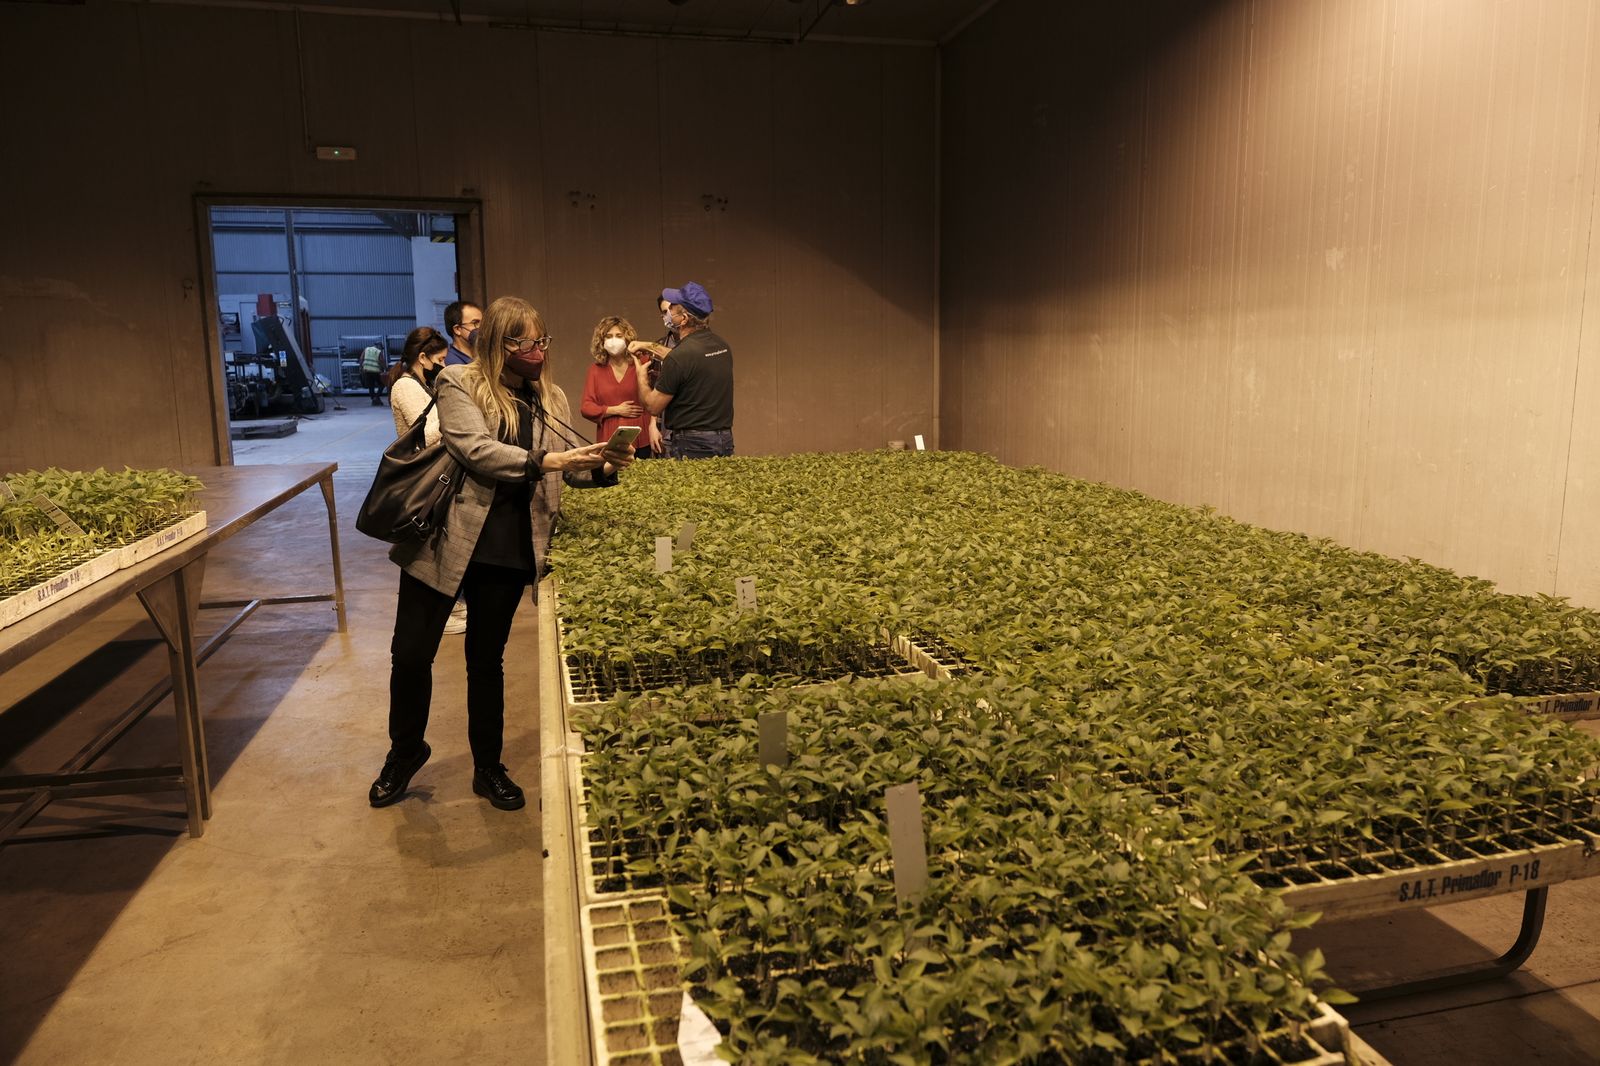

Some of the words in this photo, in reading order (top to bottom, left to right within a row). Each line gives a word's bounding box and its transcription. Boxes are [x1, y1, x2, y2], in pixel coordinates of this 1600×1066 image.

[1553, 697, 1593, 712] Primaflor
[1399, 878, 1437, 902] S.A.T.
[1441, 868, 1502, 895] Primaflor
[1509, 859, 1541, 886] P-18
